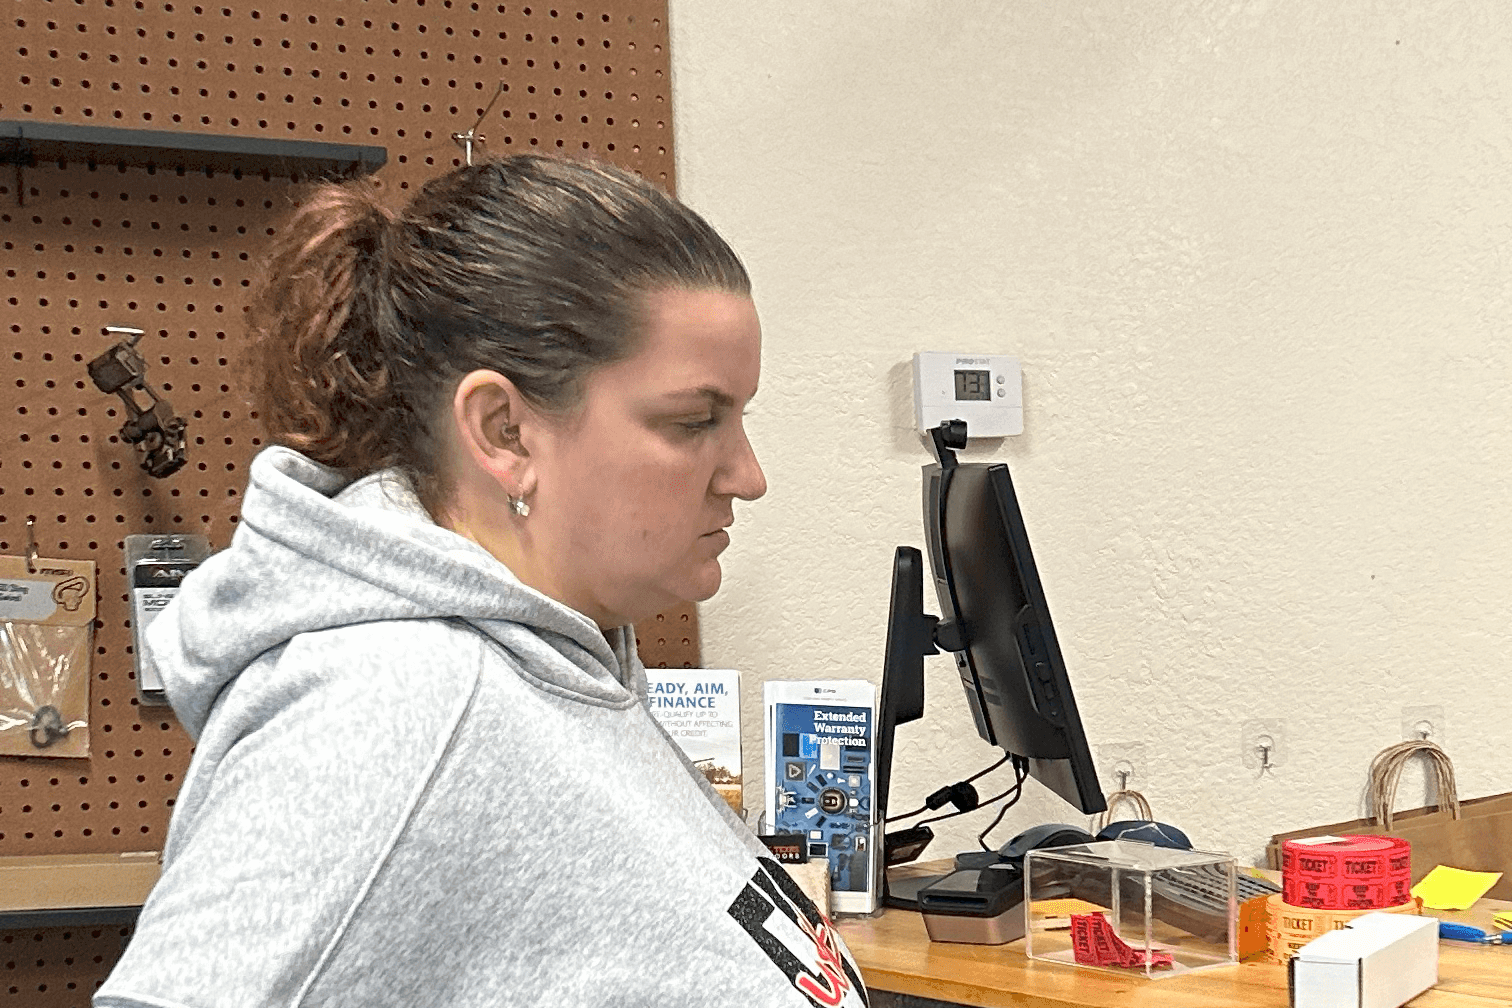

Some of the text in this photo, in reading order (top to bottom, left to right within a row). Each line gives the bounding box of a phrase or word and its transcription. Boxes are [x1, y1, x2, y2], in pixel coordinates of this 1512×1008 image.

[647, 682, 729, 696] EADY, AIM,
[649, 697, 716, 708] FINANCE
[814, 710, 867, 722] Extended
[814, 722, 867, 737] Warranty
[809, 734, 867, 746] Protection
[1283, 917, 1314, 931] TICKET
